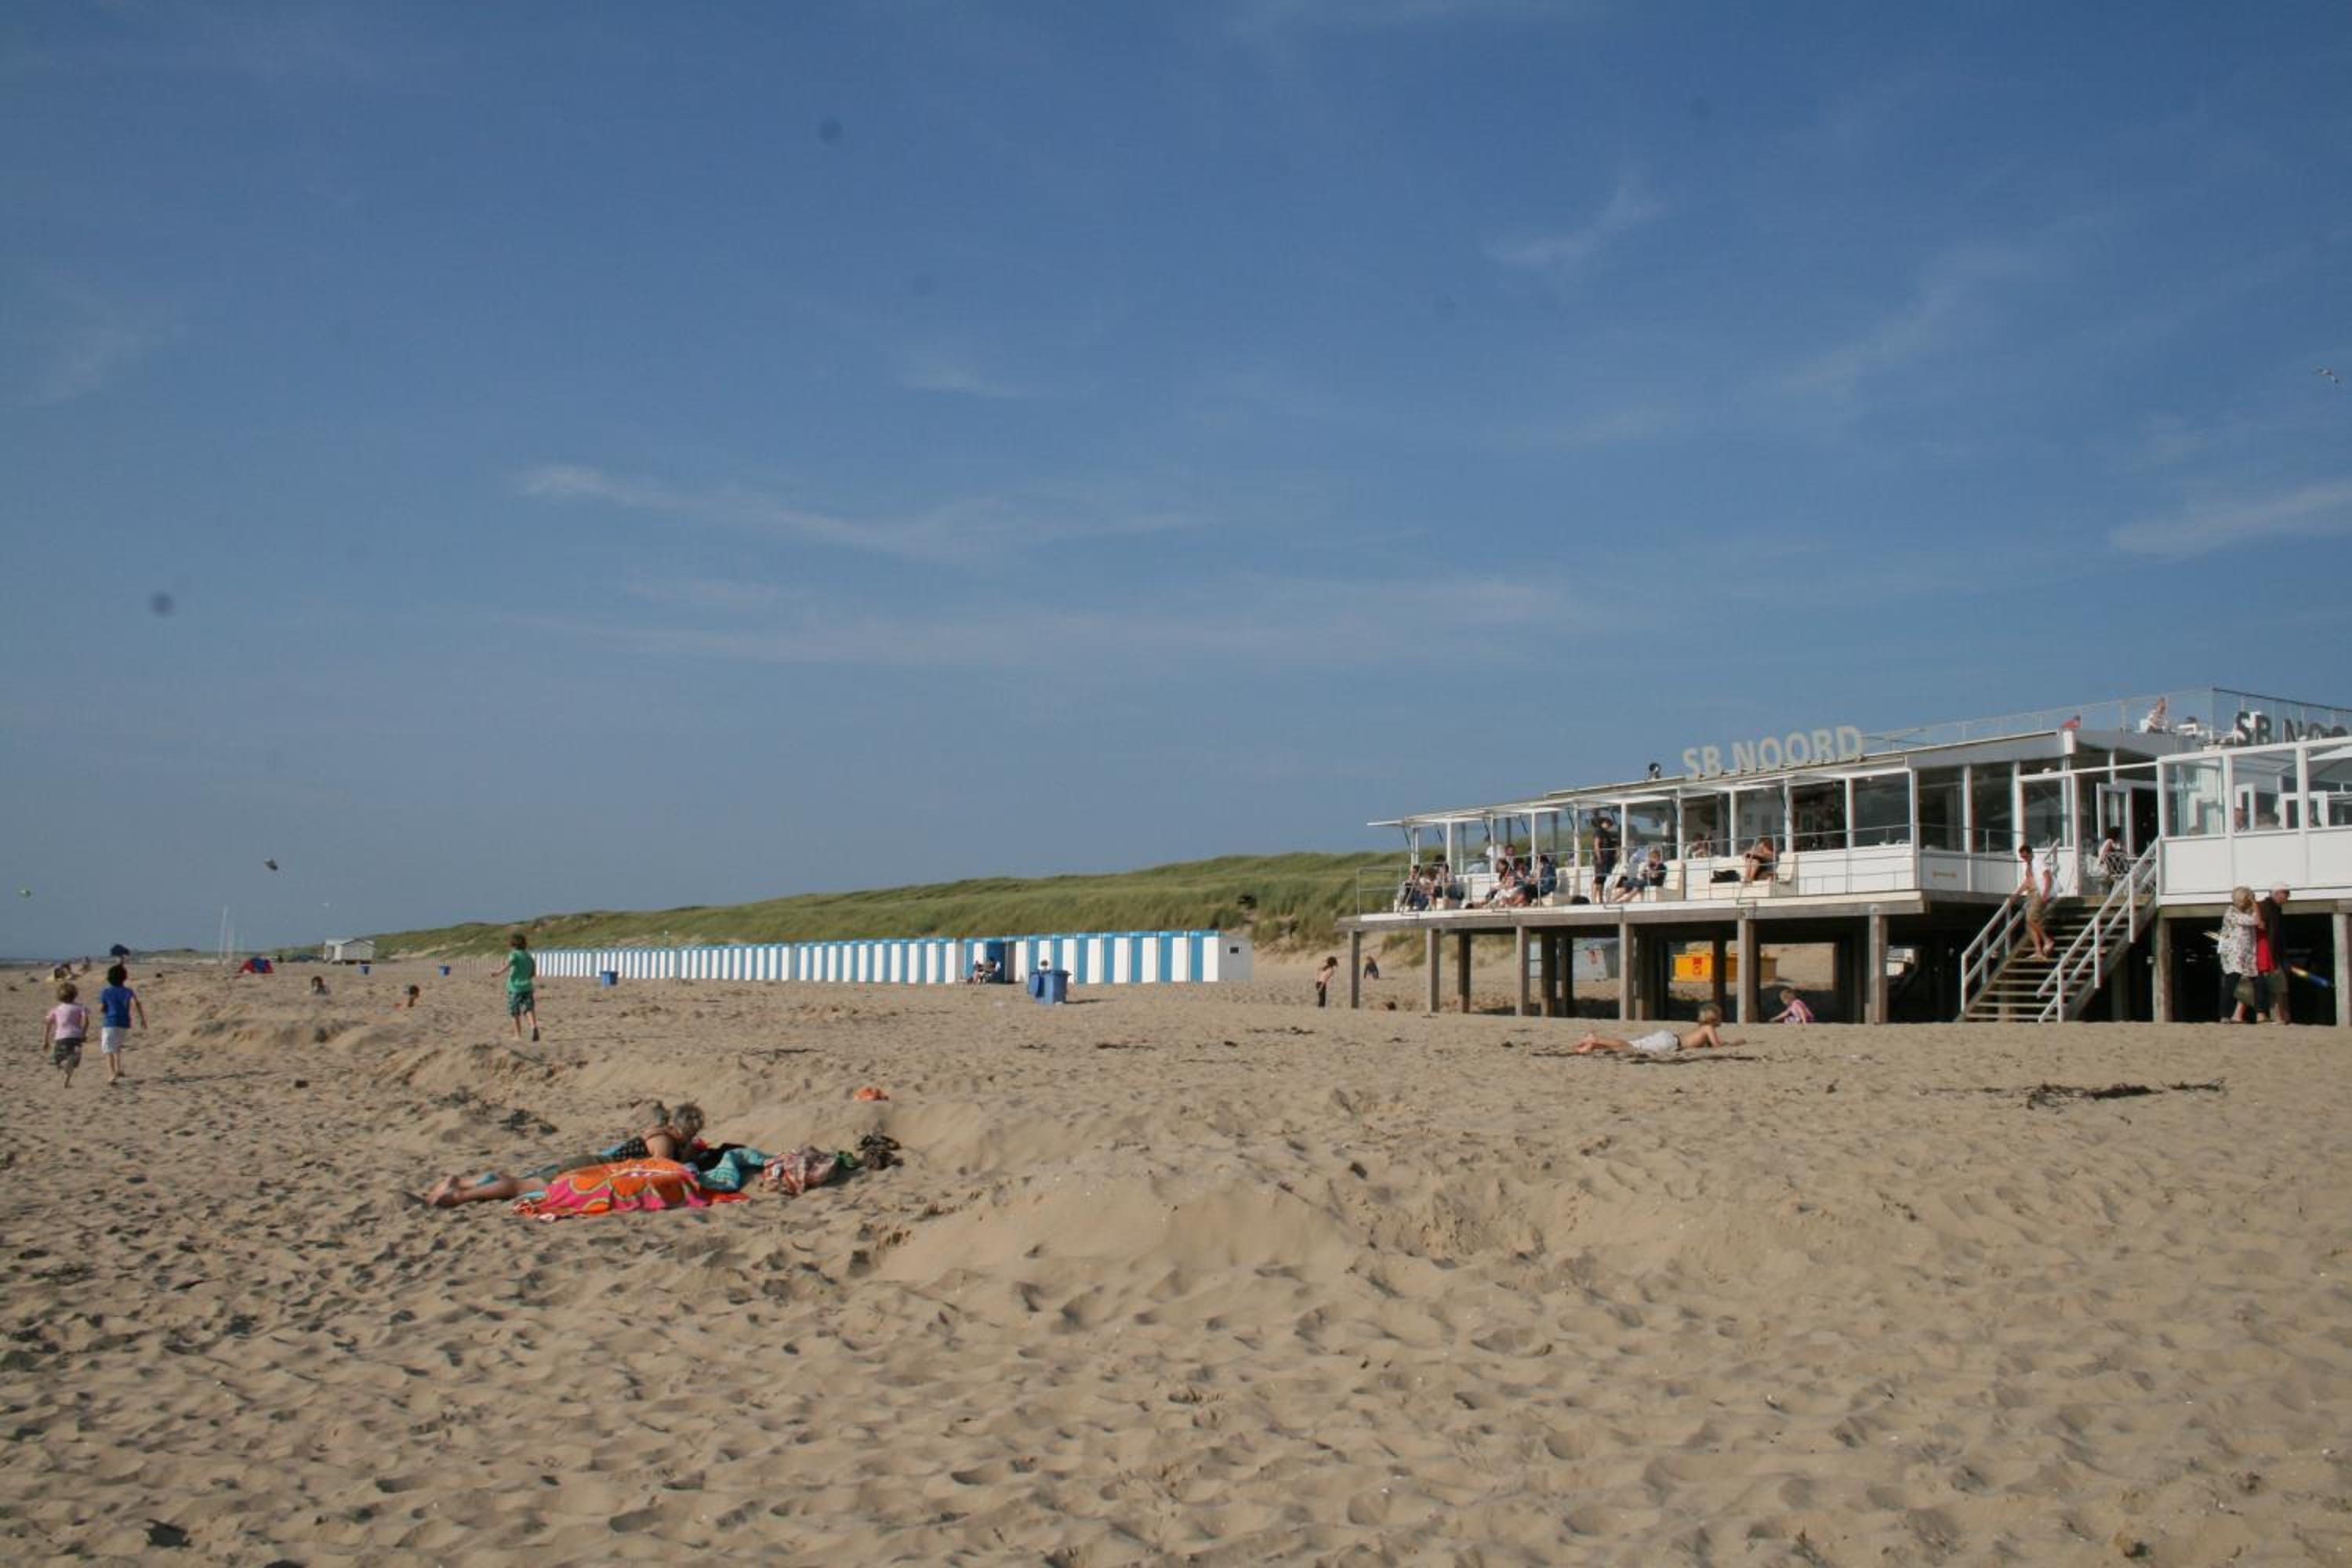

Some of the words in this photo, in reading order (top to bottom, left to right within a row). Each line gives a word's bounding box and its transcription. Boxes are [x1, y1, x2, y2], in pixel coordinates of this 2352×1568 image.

[2234, 711, 2271, 746] SB
[1683, 745, 1722, 779] SB
[1731, 726, 1863, 775] NOORD
